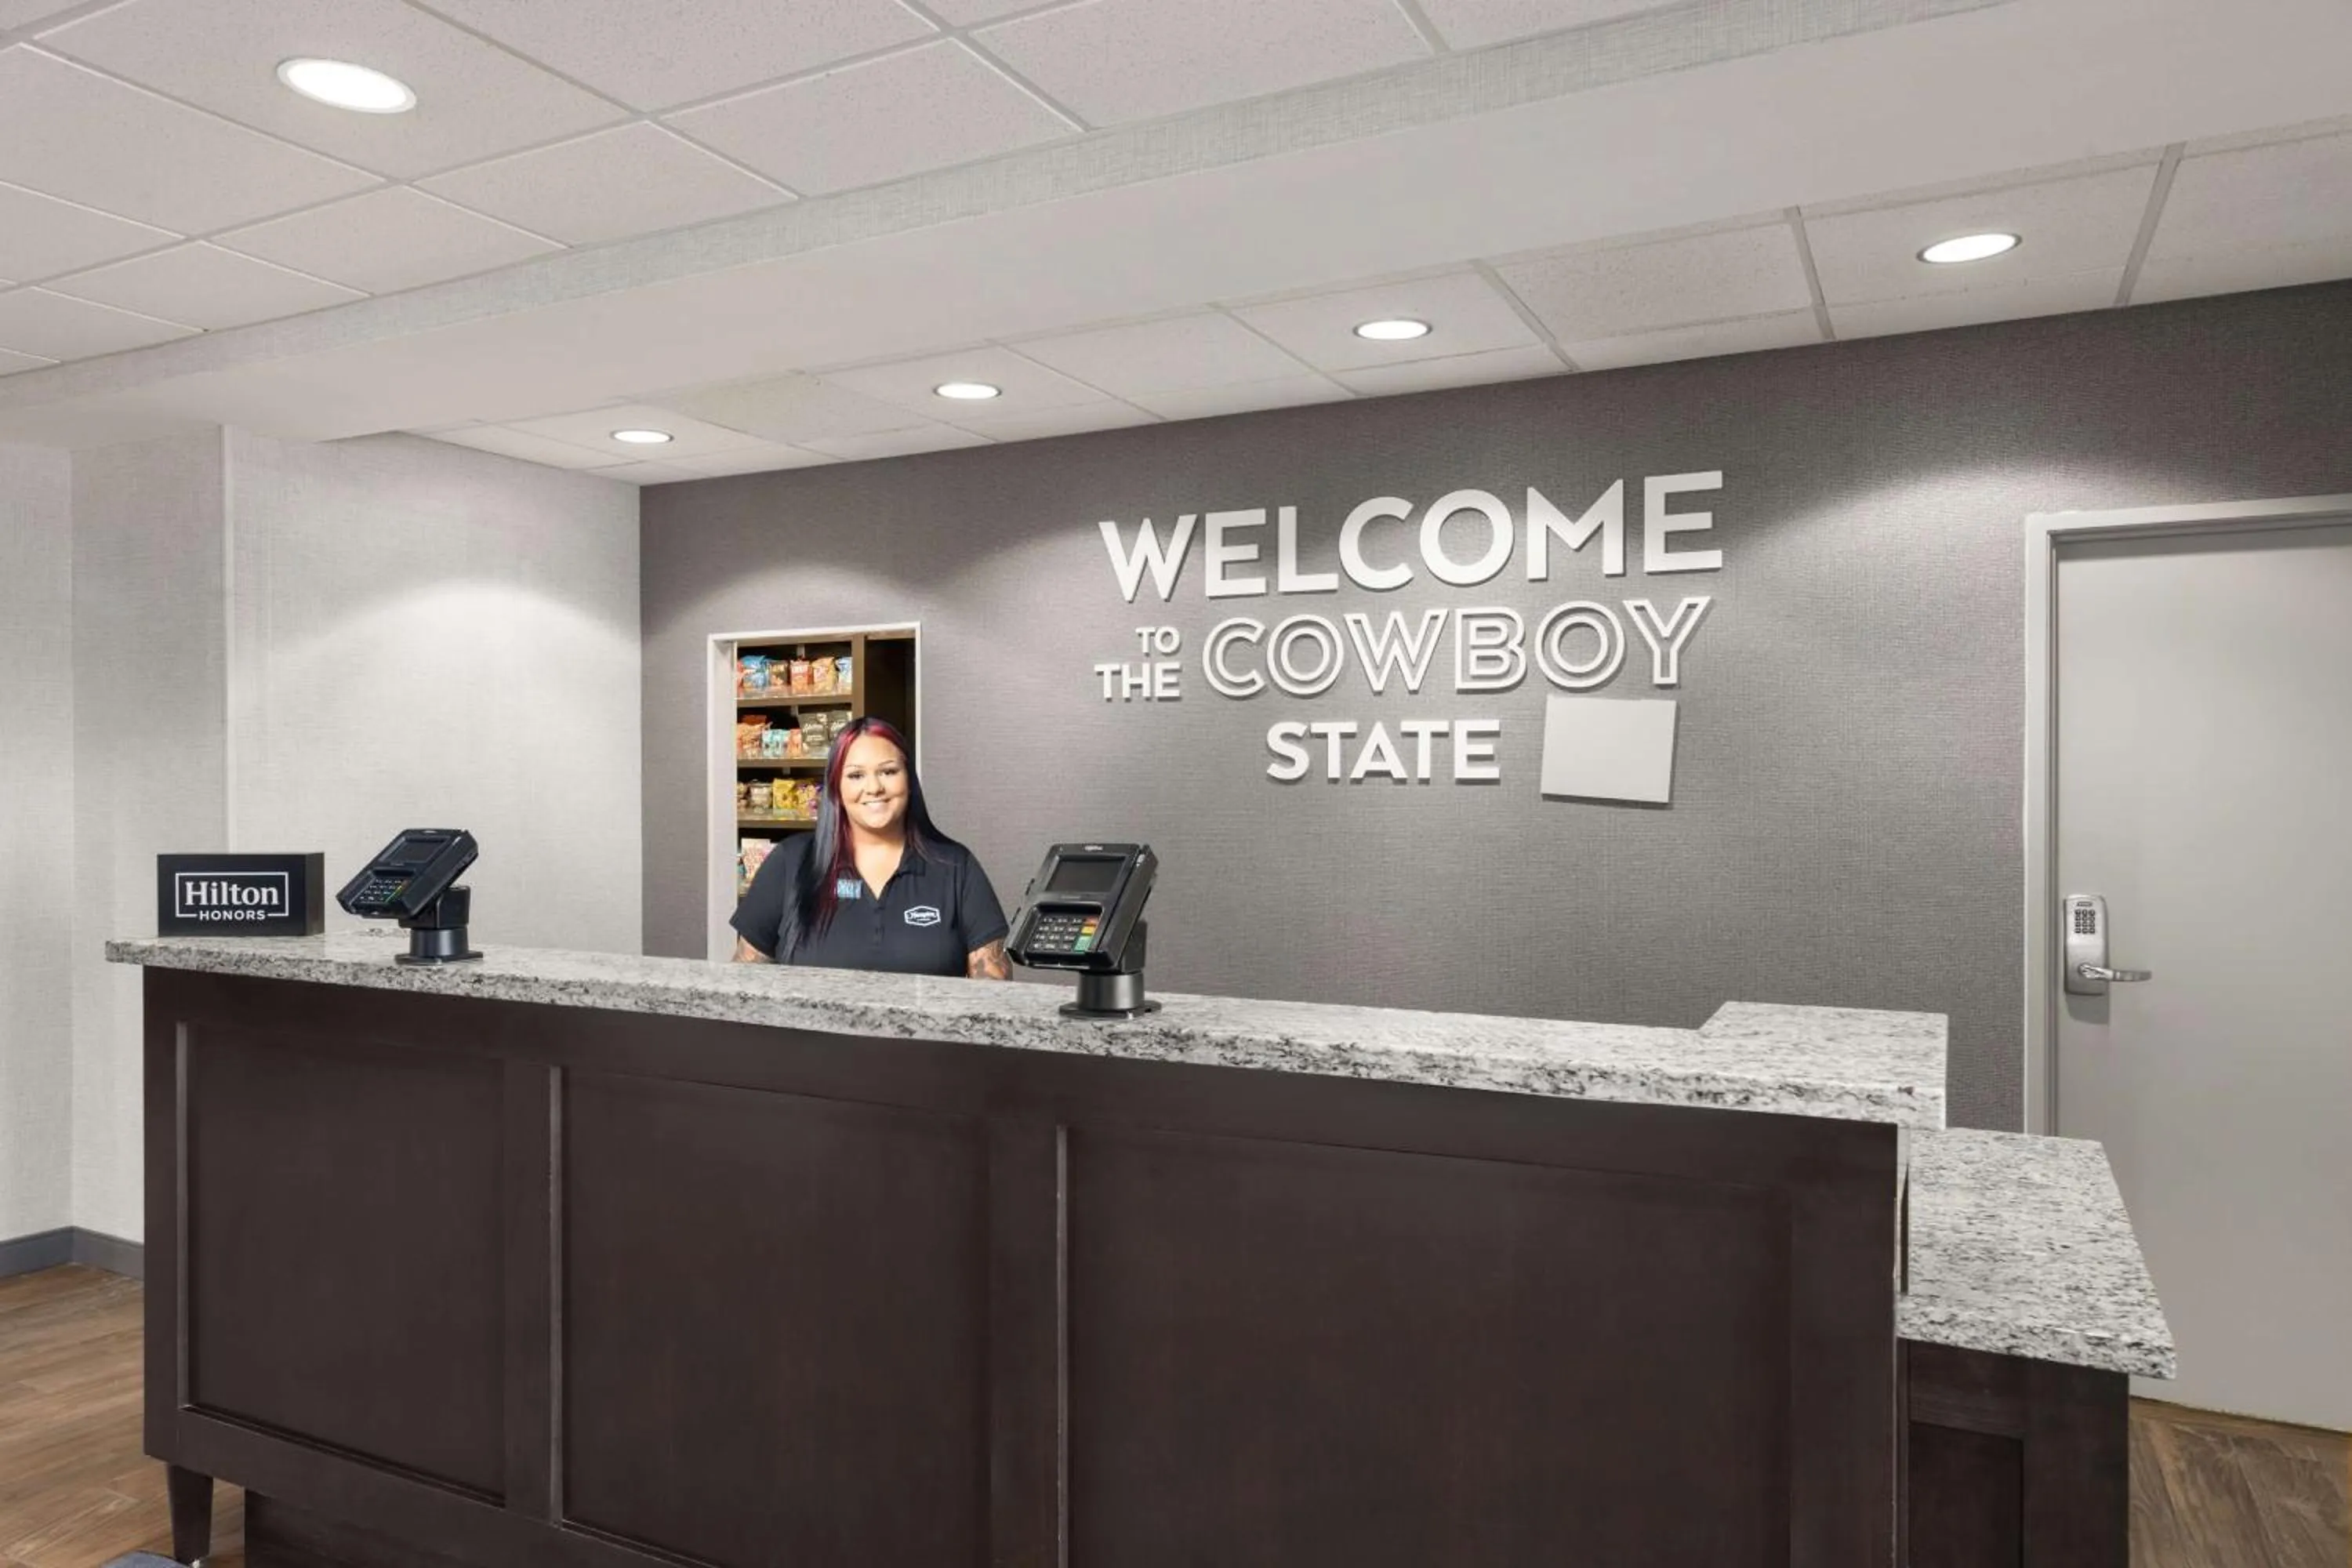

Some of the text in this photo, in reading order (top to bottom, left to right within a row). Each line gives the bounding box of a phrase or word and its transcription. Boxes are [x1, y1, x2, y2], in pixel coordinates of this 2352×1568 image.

[1098, 470, 1723, 602] WELCOME
[1094, 596, 1711, 701] THE COWBOY
[1136, 626, 1180, 654] TO
[1266, 719, 1501, 782] STATE
[185, 881, 279, 906] Hilton
[199, 910, 266, 920] HONORS
